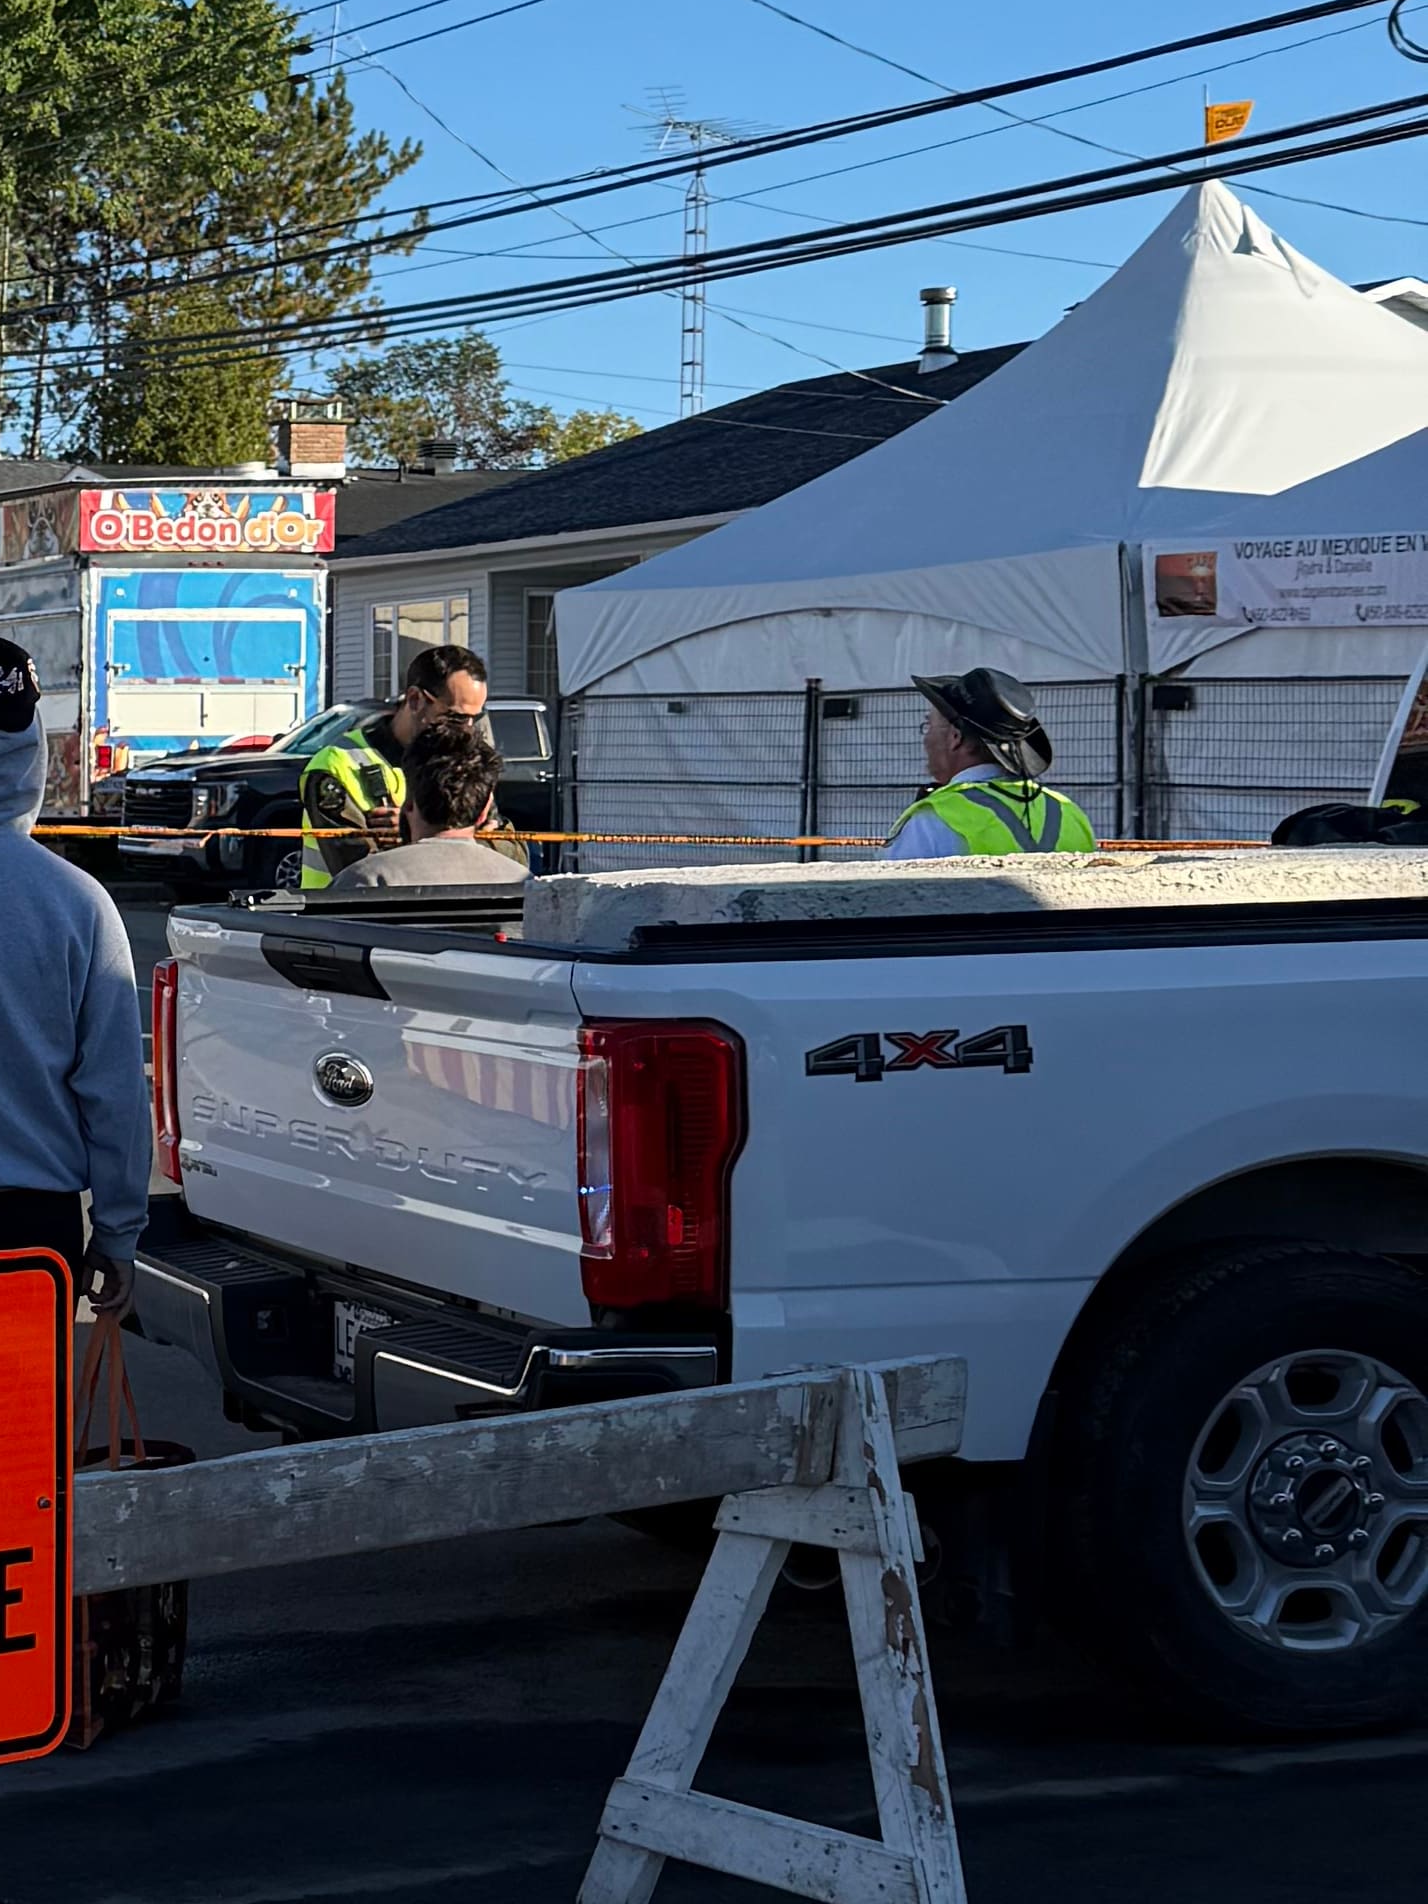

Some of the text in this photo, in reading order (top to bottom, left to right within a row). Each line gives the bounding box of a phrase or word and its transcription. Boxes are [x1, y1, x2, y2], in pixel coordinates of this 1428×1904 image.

[92, 511, 323, 545] O'Bedon d'Or
[1234, 540, 1293, 559] VOYAGE
[1295, 539, 1317, 557] AU
[1320, 535, 1391, 556] MEXIQUE
[1396, 534, 1416, 553] EN
[322, 1062, 355, 1090] Ford
[192, 1095, 548, 1203] SUPER DUTY
